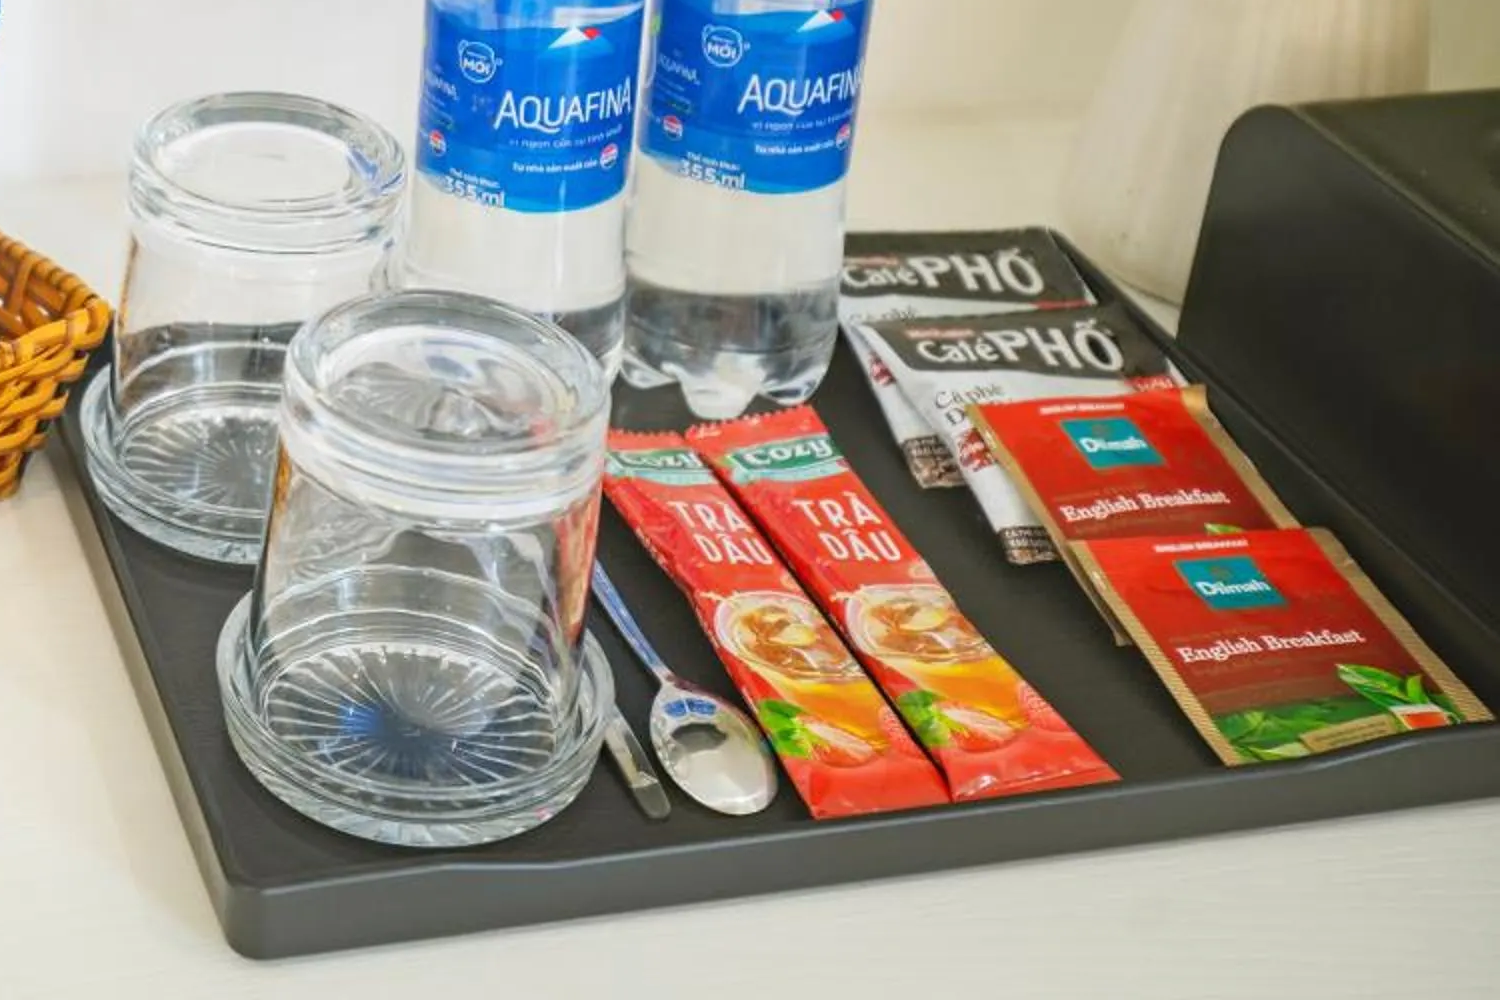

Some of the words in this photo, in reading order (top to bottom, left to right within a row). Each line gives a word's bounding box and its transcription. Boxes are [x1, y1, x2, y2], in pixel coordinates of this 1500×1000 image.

[493, 76, 632, 134] AQUAFINA
[744, 438, 835, 466] Cozy
[667, 499, 753, 533] TRÀ
[792, 491, 882, 527] TRÀ
[1059, 495, 1140, 523] English
[1138, 488, 1231, 510] Breakfast
[693, 533, 773, 565] DÂU
[818, 531, 901, 561] DÂU
[1196, 578, 1271, 597] Dilmah
[1176, 637, 1263, 664] English
[1260, 628, 1368, 651] Breakfast
